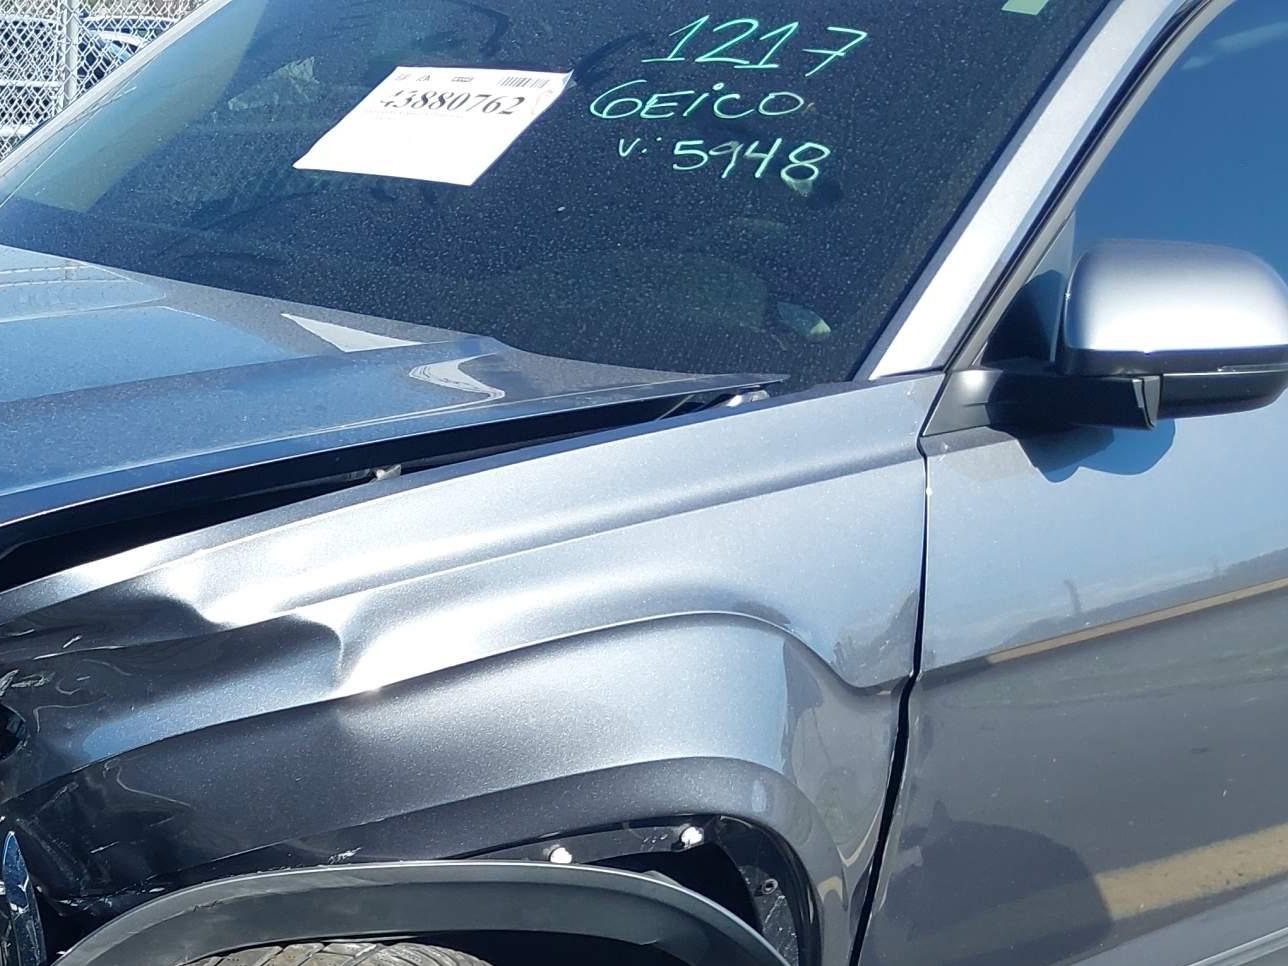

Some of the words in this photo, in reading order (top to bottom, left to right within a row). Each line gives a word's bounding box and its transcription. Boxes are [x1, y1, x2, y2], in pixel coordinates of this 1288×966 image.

[641, 15, 867, 77] 1217
[379, 89, 526, 115] 43880762
[672, 138, 831, 181] 5948
